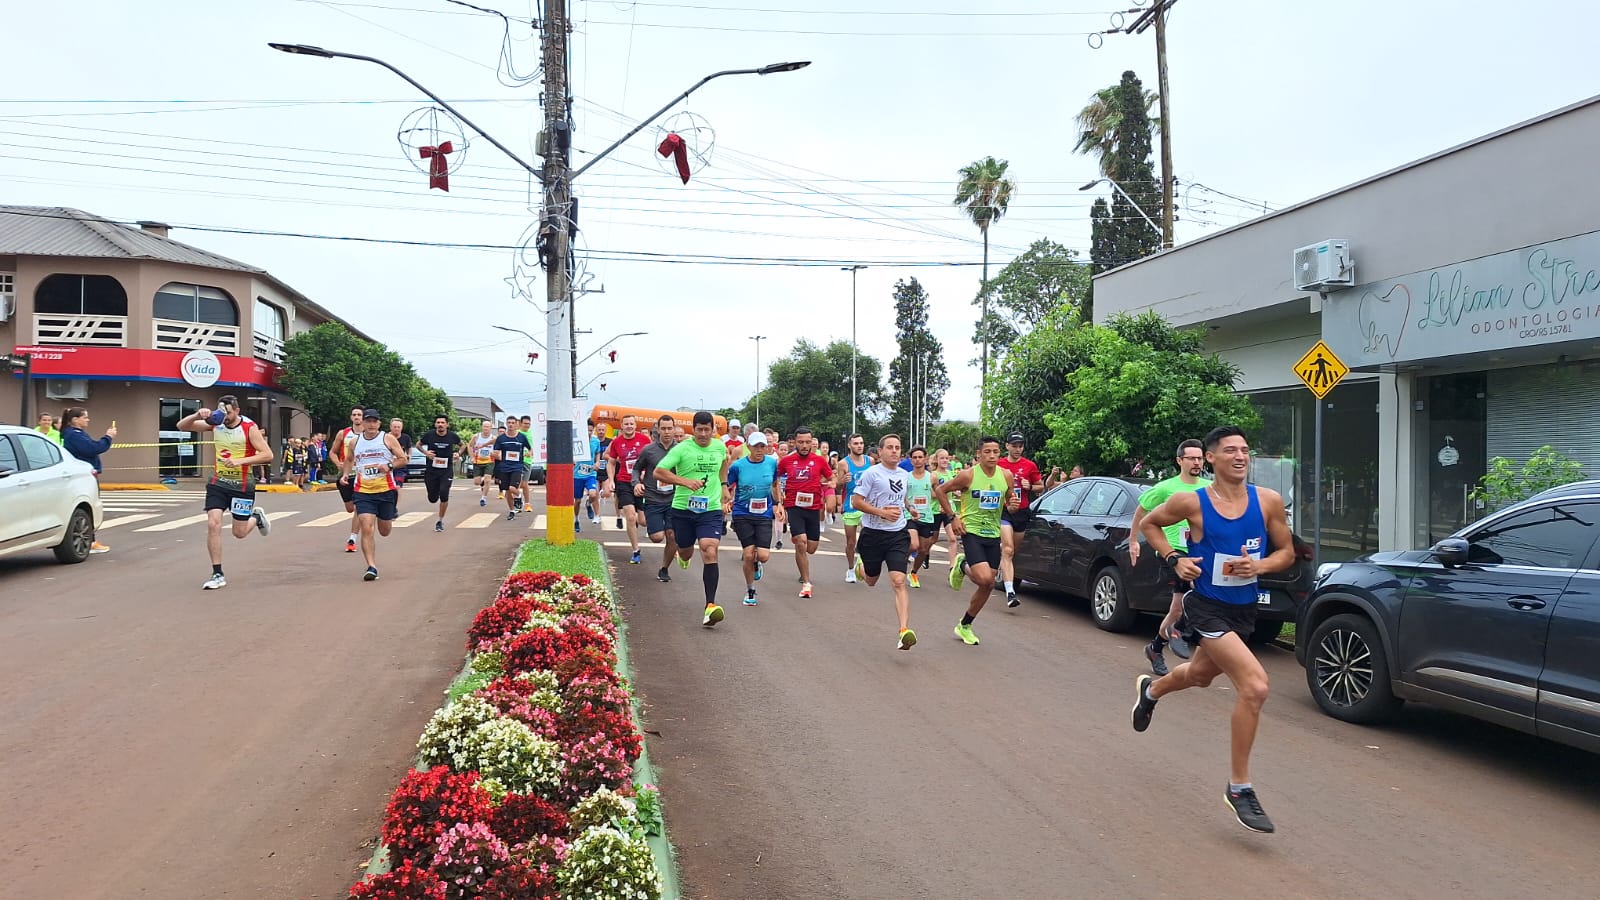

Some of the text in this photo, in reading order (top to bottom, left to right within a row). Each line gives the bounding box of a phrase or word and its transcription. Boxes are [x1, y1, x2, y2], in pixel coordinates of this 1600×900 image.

[1417, 269, 1514, 328] Lilian
[1471, 304, 1600, 334] ODONTOLOGIA
[190, 364, 216, 375] Vida
